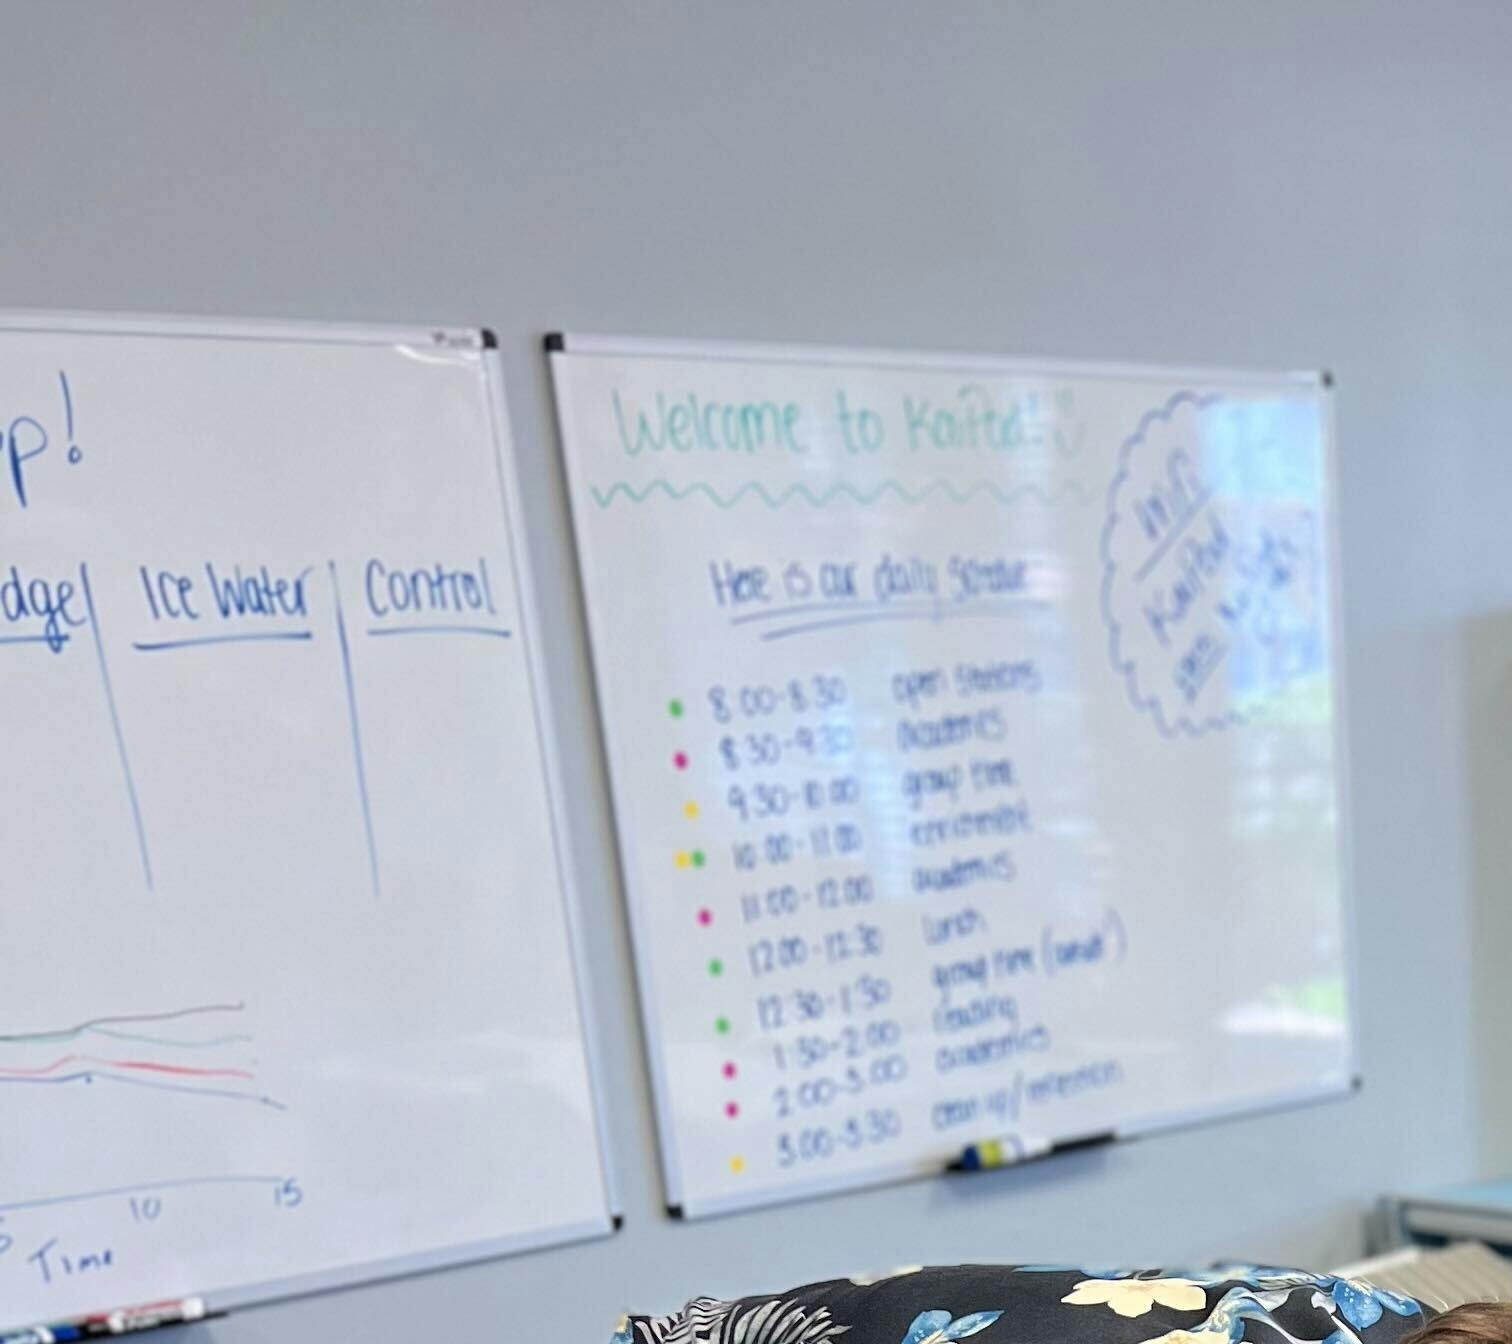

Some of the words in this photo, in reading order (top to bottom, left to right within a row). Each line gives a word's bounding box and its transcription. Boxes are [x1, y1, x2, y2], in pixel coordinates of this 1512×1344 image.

[612, 388, 806, 458] Welcome
[836, 388, 884, 455] to
[140, 566, 198, 620] Ice
[206, 562, 311, 618] Water
[367, 558, 496, 616] Control
[708, 558, 770, 606] Here
[782, 560, 814, 602] is
[130, 1196, 162, 1222] 10
[274, 1177, 303, 1207] 15
[28, 1239, 113, 1285] Time
